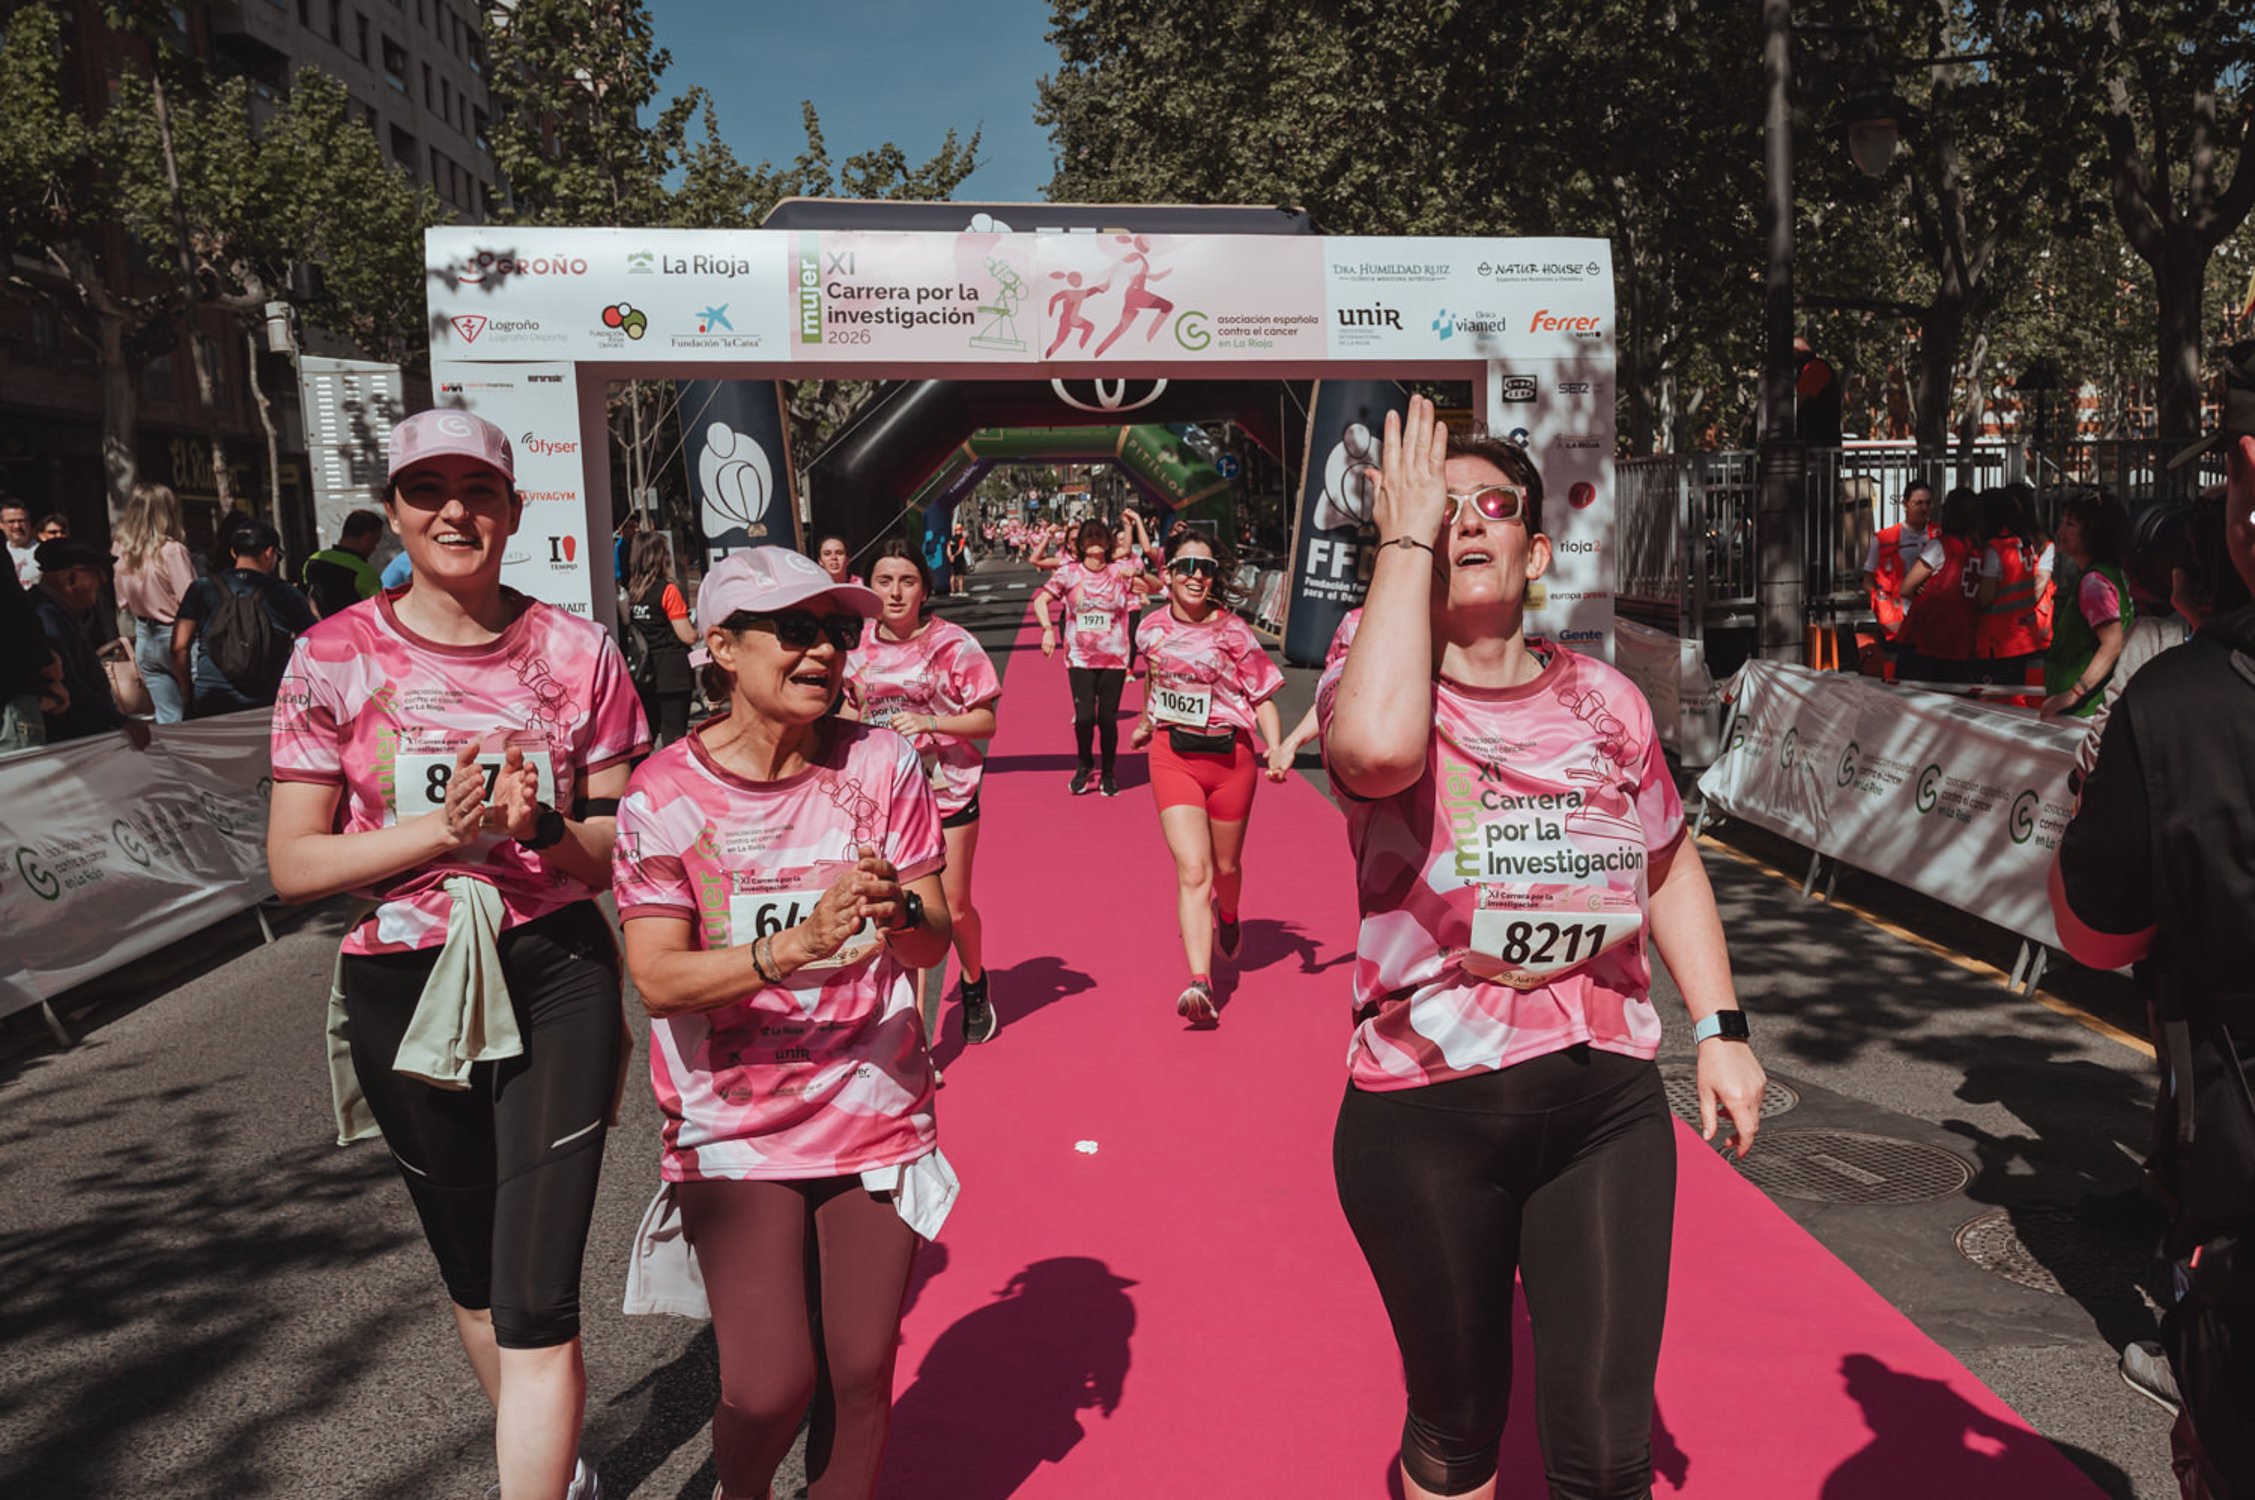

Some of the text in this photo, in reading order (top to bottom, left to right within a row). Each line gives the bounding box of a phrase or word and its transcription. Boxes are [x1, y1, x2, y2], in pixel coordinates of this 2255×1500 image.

[466, 251, 588, 276] LOGROÑO
[663, 253, 750, 278] La Rioja
[827, 252, 855, 275] XI
[1360, 262, 1422, 275] HUMILDAD
[1425, 264, 1451, 275] RUIZ
[1495, 264, 1583, 274] NATUR HOUSE
[798, 259, 822, 335] mujer
[827, 283, 979, 304] Carrera por la
[827, 306, 975, 328] investigación
[1217, 315, 1319, 325] asociación española
[1529, 309, 1601, 333] ferrer
[489, 319, 540, 332] Logroño
[1217, 327, 1251, 336] contra
[1253, 327, 1261, 336] el
[1456, 318, 1506, 332] viamed
[671, 338, 719, 348] Fundación
[827, 329, 871, 344] 2026
[1219, 338, 1273, 349] en La Rioja
[1558, 383, 1589, 394] SER
[1560, 540, 1600, 554] rioja2
[1305, 576, 1350, 592] Fundación
[1550, 592, 1581, 601] europa
[1084, 615, 1104, 625] 1971
[1559, 629, 1603, 640] Gente
[1160, 691, 1204, 715] 10621
[370, 723, 397, 808] ujer
[1476, 762, 1502, 783] XI
[1480, 789, 1584, 811] Carrera
[1444, 756, 1484, 878] mujer
[1485, 817, 1561, 848] por la
[2045, 835, 2056, 850] La
[1487, 846, 1644, 880] Investigación
[780, 877, 792, 885] por
[1488, 889, 1554, 903] XI Carrera por la
[700, 871, 731, 949] ujer
[1502, 921, 1607, 965] 8211
